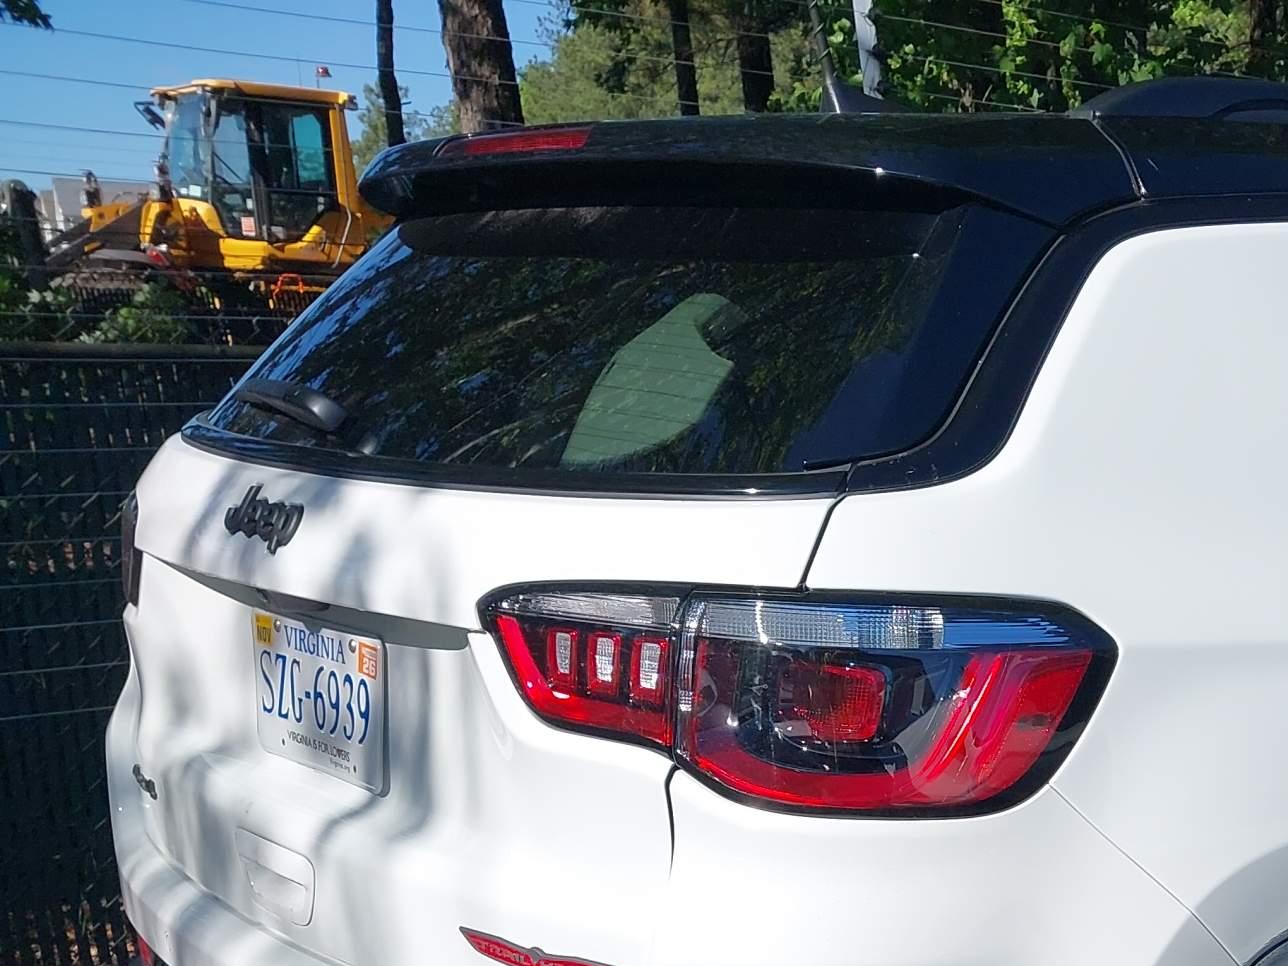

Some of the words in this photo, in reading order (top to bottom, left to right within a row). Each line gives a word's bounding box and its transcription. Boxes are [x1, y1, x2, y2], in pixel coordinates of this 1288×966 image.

[224, 484, 304, 556] Jeep
[256, 623, 272, 644] NOV
[284, 624, 346, 664] VIRGINIA
[362, 656, 376, 677] 26
[260, 649, 371, 745] SZG-6939
[287, 731, 312, 748] VIRGINIA
